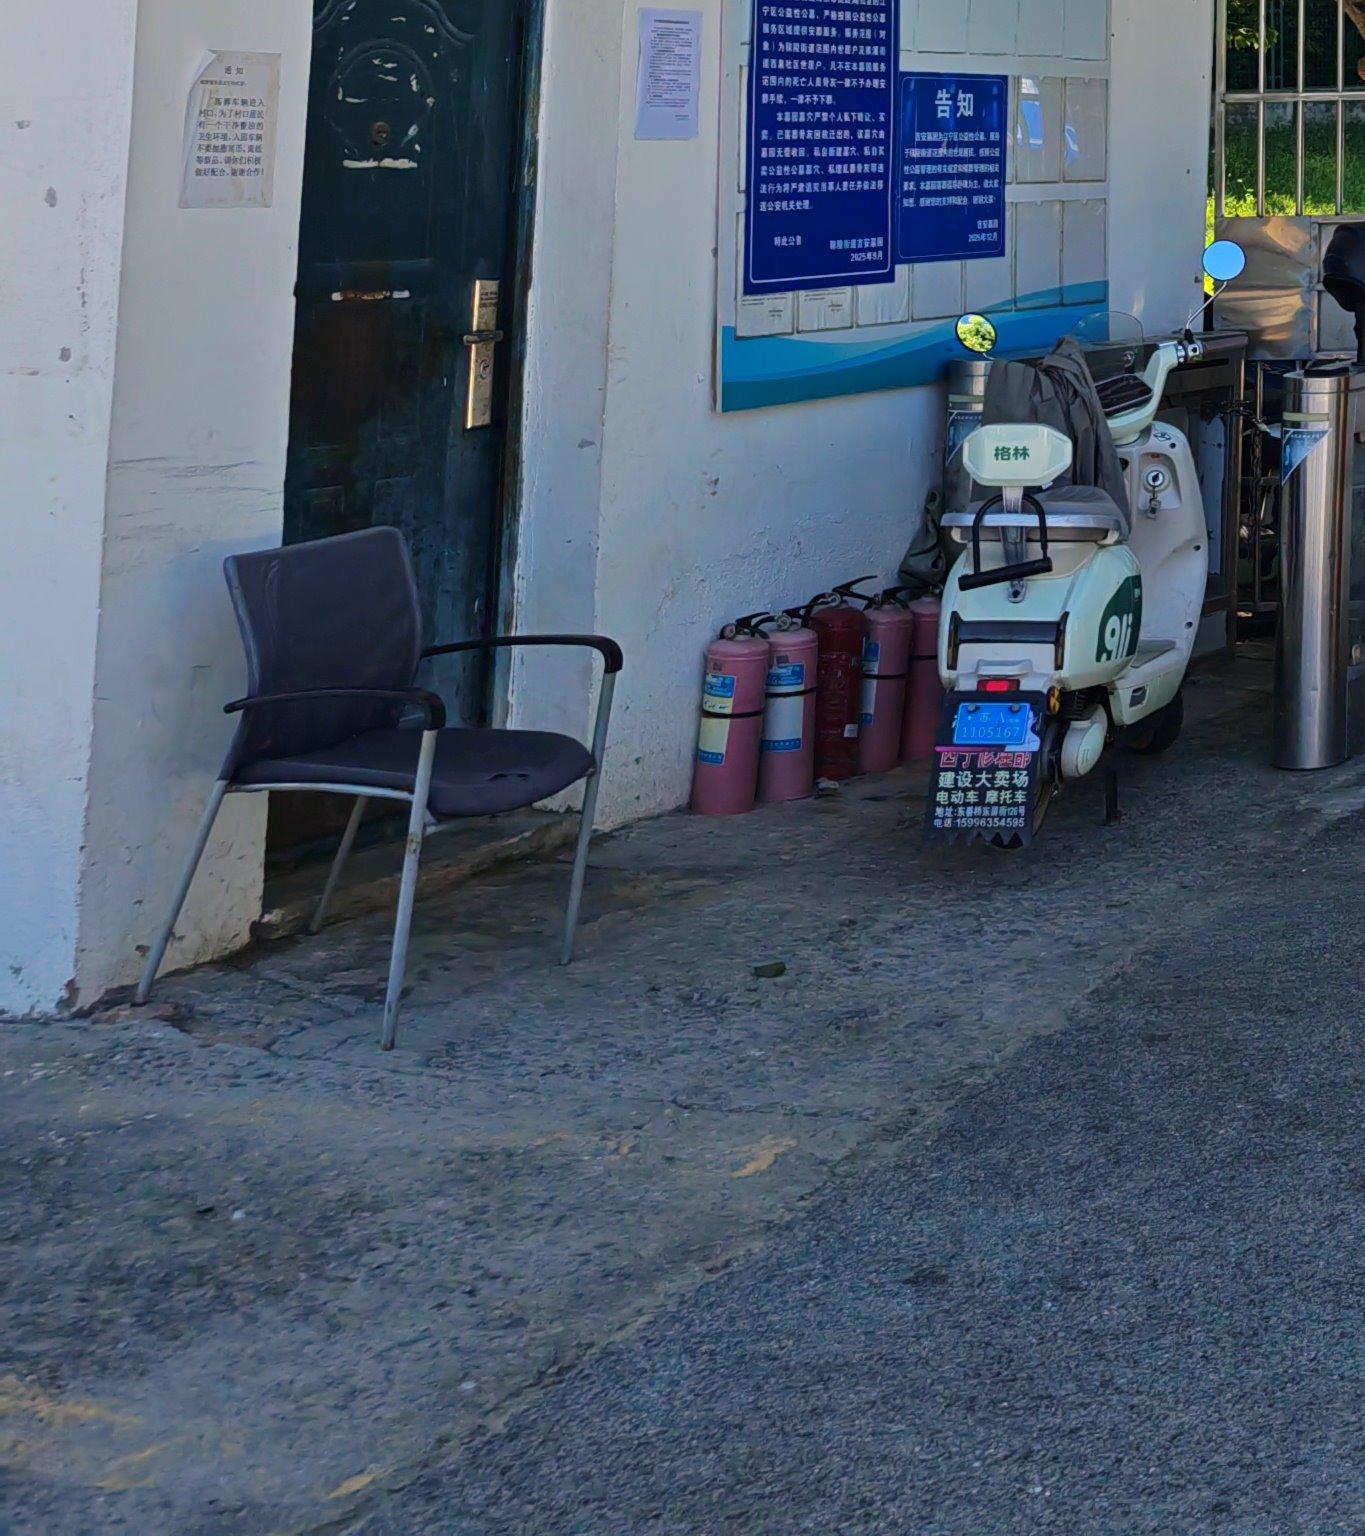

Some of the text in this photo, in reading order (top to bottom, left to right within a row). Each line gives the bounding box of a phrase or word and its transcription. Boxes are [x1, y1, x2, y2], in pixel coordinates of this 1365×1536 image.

[224, 66, 244, 75] 通知
[935, 88, 974, 119] 告知
[993, 445, 1031, 463] 格林
[938, 770, 1029, 788] 建设大卖场
[936, 789, 1027, 805] 电动车 摩托车
